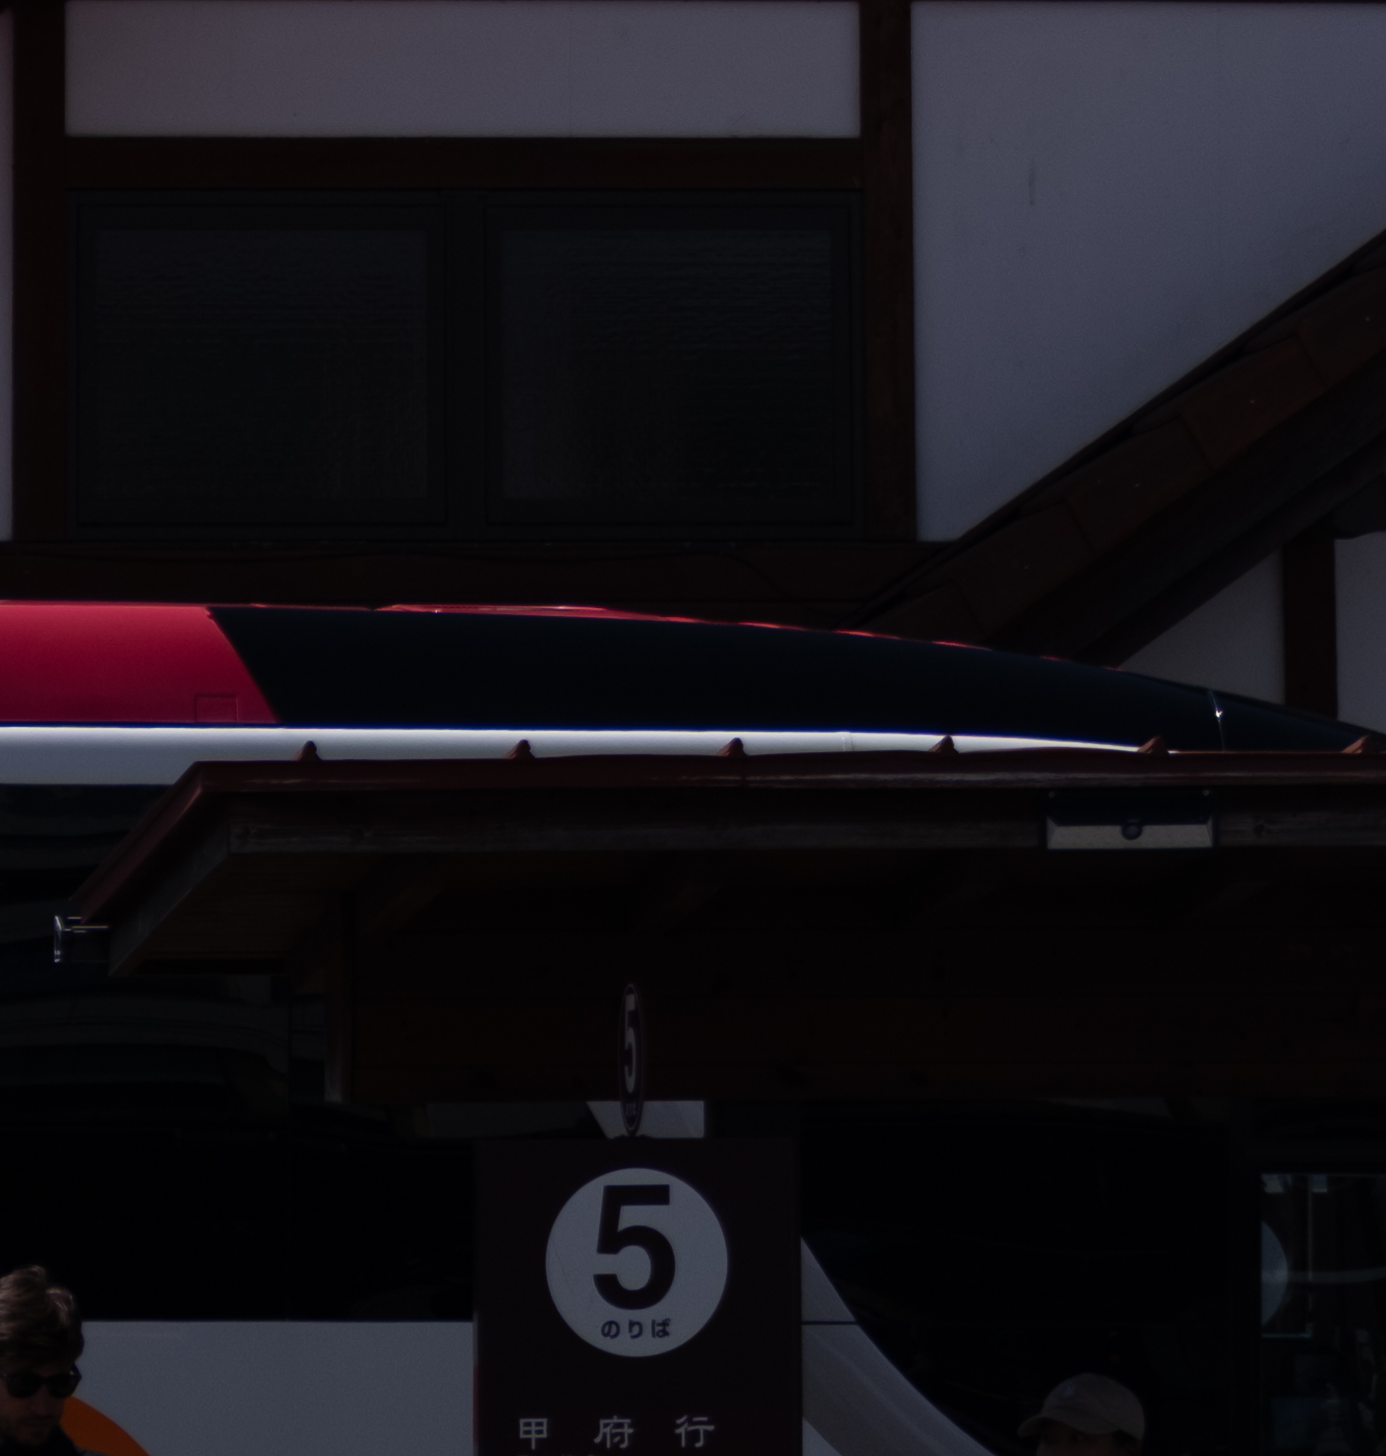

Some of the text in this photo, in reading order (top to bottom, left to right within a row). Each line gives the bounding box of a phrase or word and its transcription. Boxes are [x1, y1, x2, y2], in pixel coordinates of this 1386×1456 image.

[622, 993, 638, 1094] 5
[593, 1184, 676, 1311] 5
[600, 1318, 671, 1340] のりば
[518, 1414, 716, 1451] 甲府行
